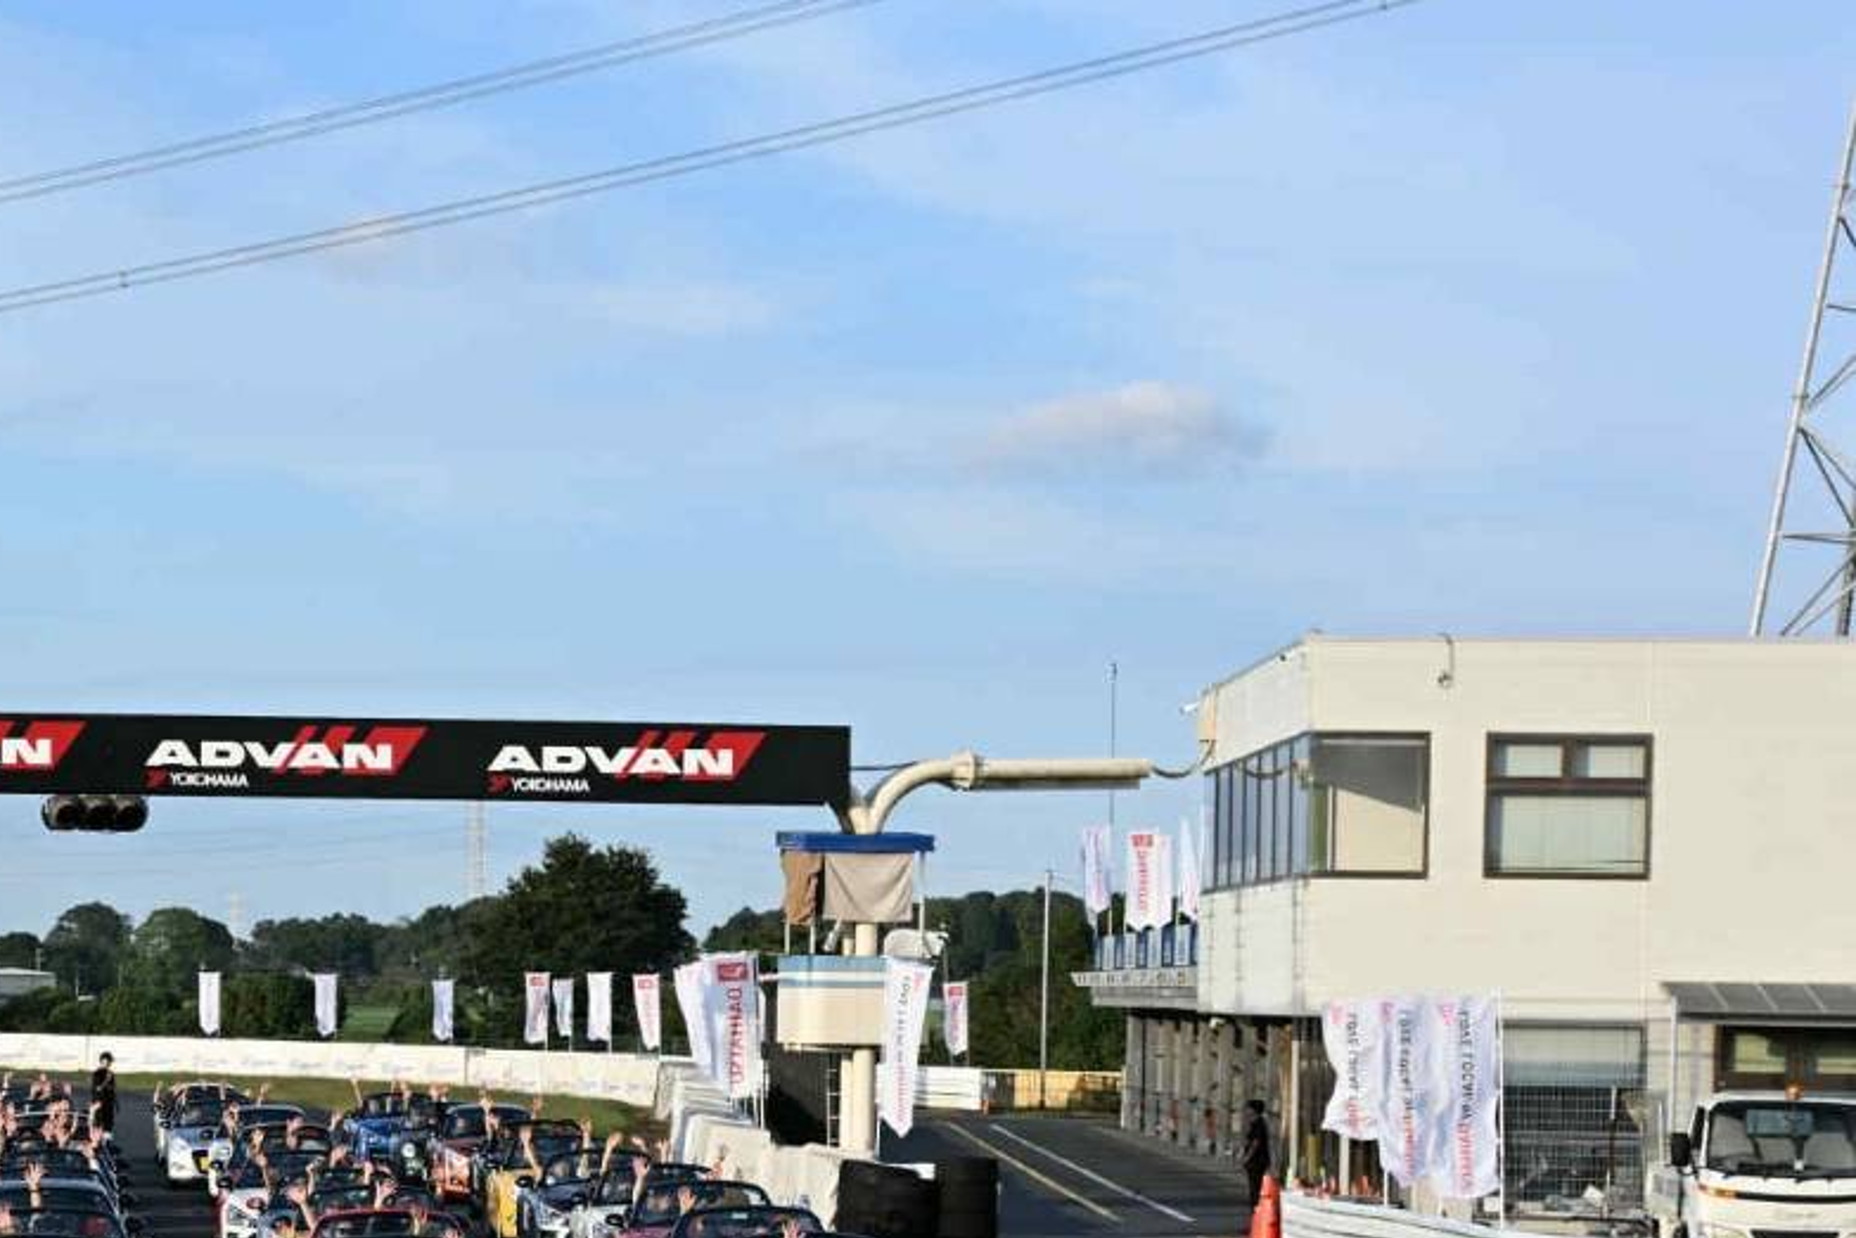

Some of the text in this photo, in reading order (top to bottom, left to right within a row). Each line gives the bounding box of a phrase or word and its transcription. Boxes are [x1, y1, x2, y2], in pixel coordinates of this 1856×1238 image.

[146, 740, 392, 770] ADVAN
[488, 745, 733, 776] ADVAN
[170, 772, 249, 788] YOKOHAMA
[511, 777, 590, 792] YOKOHAMA
